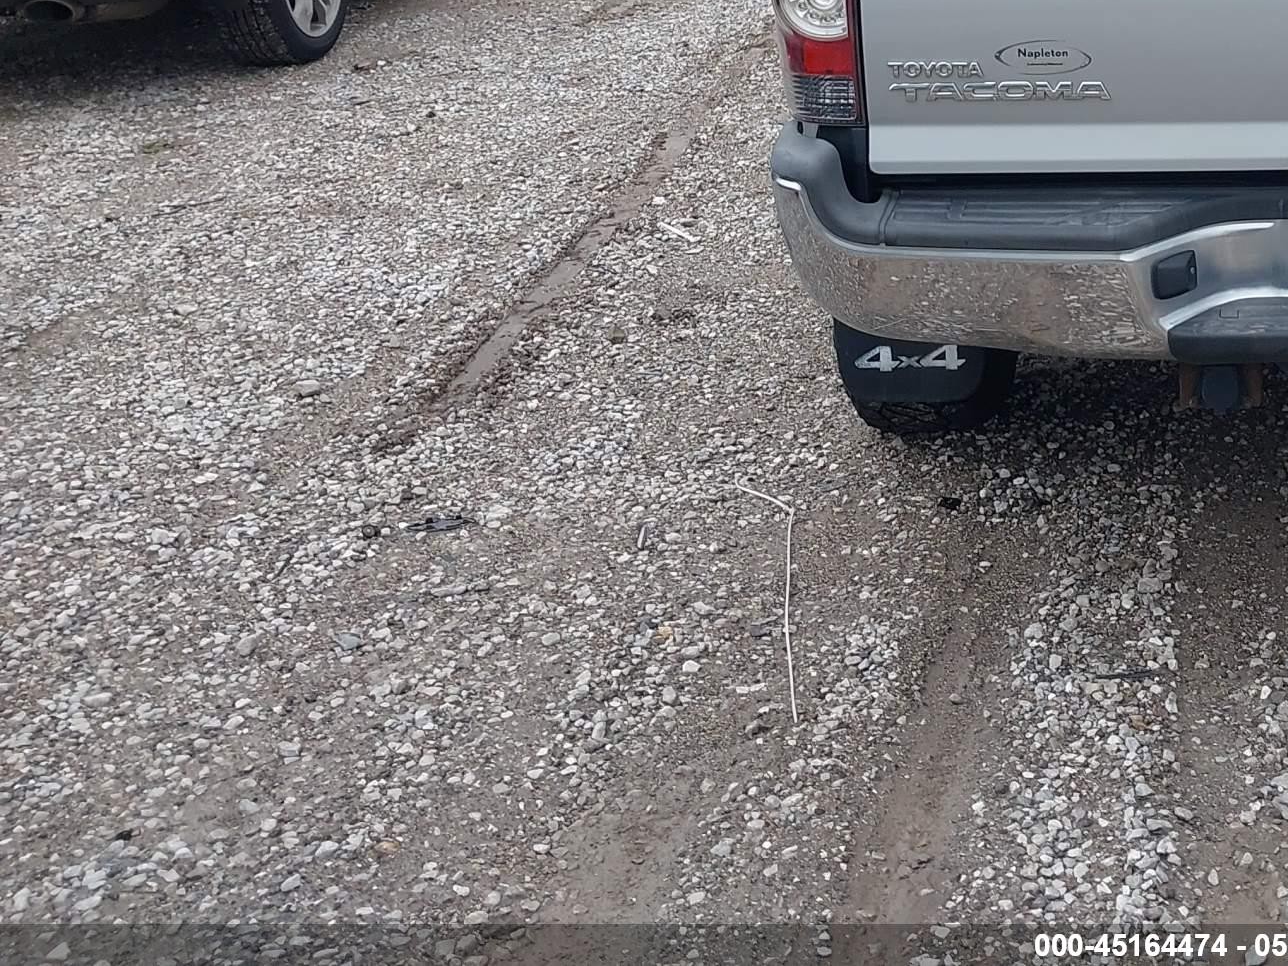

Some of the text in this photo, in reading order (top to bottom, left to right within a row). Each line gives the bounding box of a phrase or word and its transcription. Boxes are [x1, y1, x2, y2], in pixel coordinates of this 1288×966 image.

[1016, 47, 1069, 59] Napleton
[887, 61, 984, 79] TOYOTA
[888, 81, 1112, 103] TACOMA
[854, 344, 967, 372] 4x4
